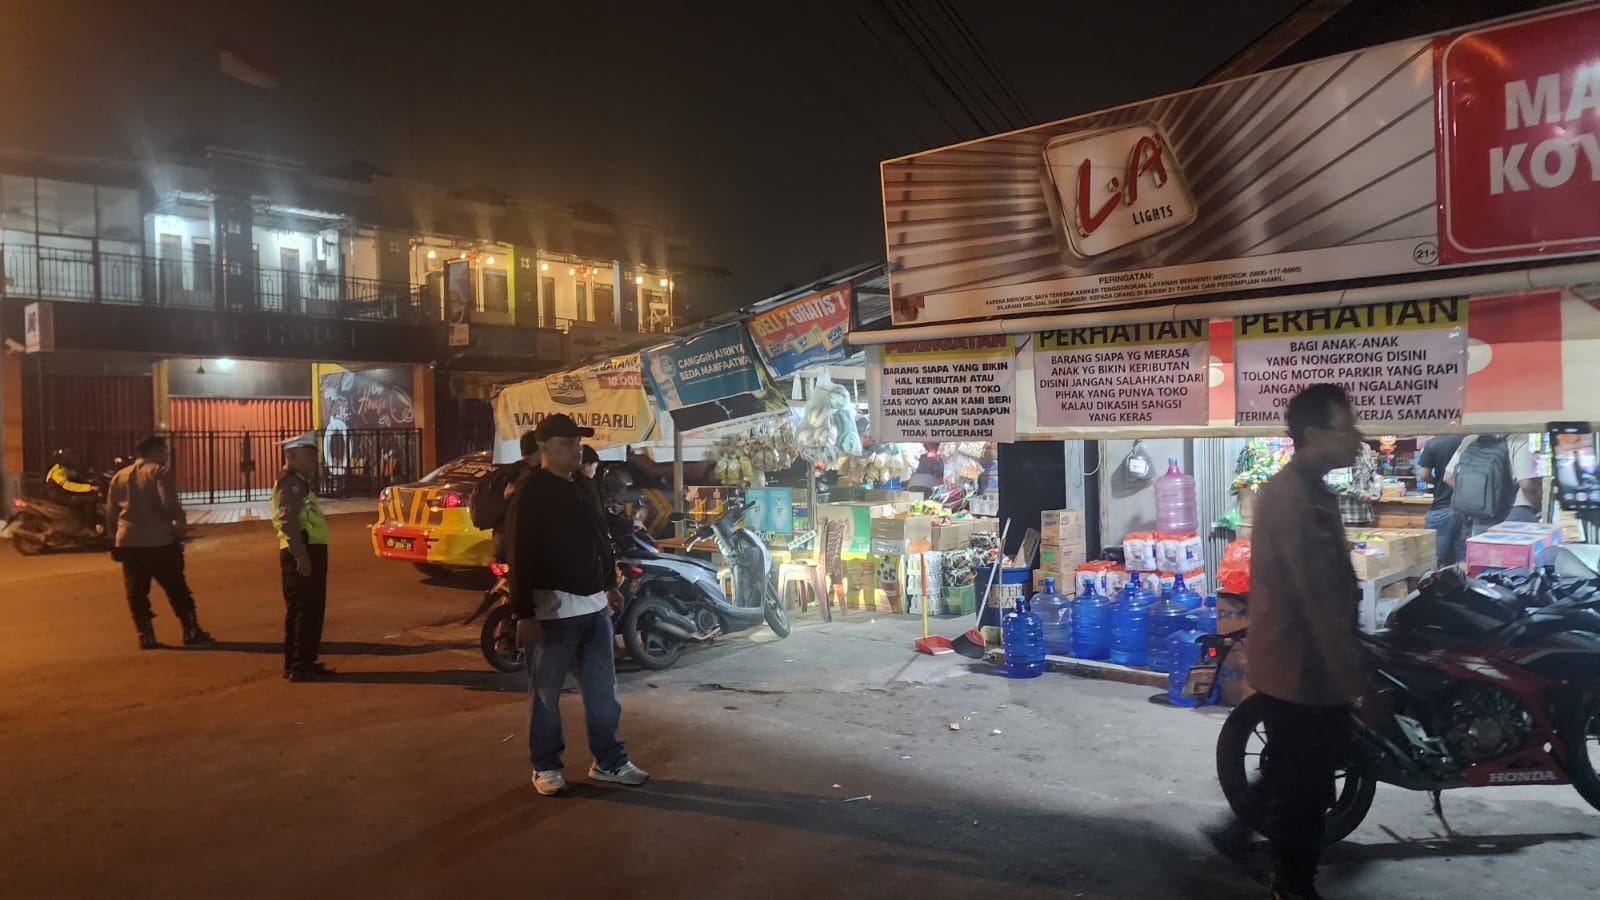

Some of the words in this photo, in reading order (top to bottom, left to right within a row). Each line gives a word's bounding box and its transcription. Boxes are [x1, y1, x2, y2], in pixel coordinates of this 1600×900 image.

[1132, 204, 1174, 226] LIGHTS
[1416, 249, 1437, 259] 21+
[752, 315, 784, 337] BELI
[780, 311, 796, 327] 2
[790, 296, 836, 323] GRATIS
[835, 291, 847, 310] 1
[1241, 298, 1458, 335] PERHATIAN
[1039, 319, 1203, 348] PERHATIAN
[1290, 341, 1318, 352] BAGI
[1321, 336, 1399, 351] ANAK-ANAK
[678, 351, 715, 369] CANGGIH
[1051, 353, 1092, 365] BARANG
[1094, 352, 1124, 362] SIAPA
[1128, 351, 1141, 361] YG
[1144, 348, 1190, 360] MERASA
[1266, 355, 1297, 367] YANG
[1301, 351, 1383, 366] NONGKRONG
[1387, 349, 1427, 362] DISINI
[679, 368, 702, 381] BEDA
[883, 367, 919, 375] BARANG
[922, 365, 949, 373] SIAPA
[952, 364, 979, 372] YANG
[982, 362, 1008, 371] BIKIN
[1051, 366, 1079, 376] ANAK
[1082, 364, 1095, 375] YG
[1098, 364, 1125, 374] BIKIN
[1129, 361, 1190, 373] KERIBUTAN
[1243, 370, 1288, 381] TOLONG
[1291, 367, 1335, 380] MOTOR
[1338, 366, 1383, 378] PARKIR
[1386, 364, 1423, 376] YANG
[1427, 363, 1458, 375] RAPI
[895, 377, 912, 385] HAL
[915, 375, 967, 384] KERIBUTAN
[970, 374, 994, 382] ATAU
[1039, 378, 1069, 388] DISINI
[1071, 376, 1113, 387] JANGAN
[1116, 374, 1175, 385] SALAHKAN
[1178, 372, 1204, 383] DARI
[891, 387, 929, 395] BERBUAT
[933, 386, 959, 395] ONAR
[975, 385, 1001, 393] TOKO
[1055, 388, 1084, 399] PIHAK
[1087, 387, 1116, 398] YANG
[1118, 387, 1154, 398] PUNYA
[1157, 386, 1188, 397] TOKO
[1258, 383, 1306, 395] JANGAN
[1359, 379, 1439, 392] NGALANGIN
[904, 397, 929, 406] KOYO
[931, 397, 958, 405] AKAN
[961, 396, 985, 404] KAMI
[988, 395, 1011, 404] BERI
[1061, 400, 1094, 411] KALAU
[1096, 400, 1138, 410] DIKASIH
[1141, 399, 1182, 410] SANGSI
[1380, 394, 1423, 406] LEWAT
[884, 408, 916, 416] SANKSI
[919, 407, 958, 416] MAUPUN
[961, 406, 1010, 415] SIAPAPUN
[1089, 412, 1116, 422] YANG
[1119, 411, 1152, 422] KERAS
[1239, 411, 1280, 422] TERIMA
[1356, 408, 1393, 420] KERJA
[1397, 408, 1462, 421] SAMANYA
[591, 413, 635, 430] BARU
[896, 419, 921, 427] ANAK
[924, 418, 970, 426] SIAPAPUN
[973, 418, 994, 426] DAN
[901, 429, 928, 437] TIDAK
[930, 428, 993, 437] DITOLERANSI
[1488, 771, 1556, 783] HONDA
